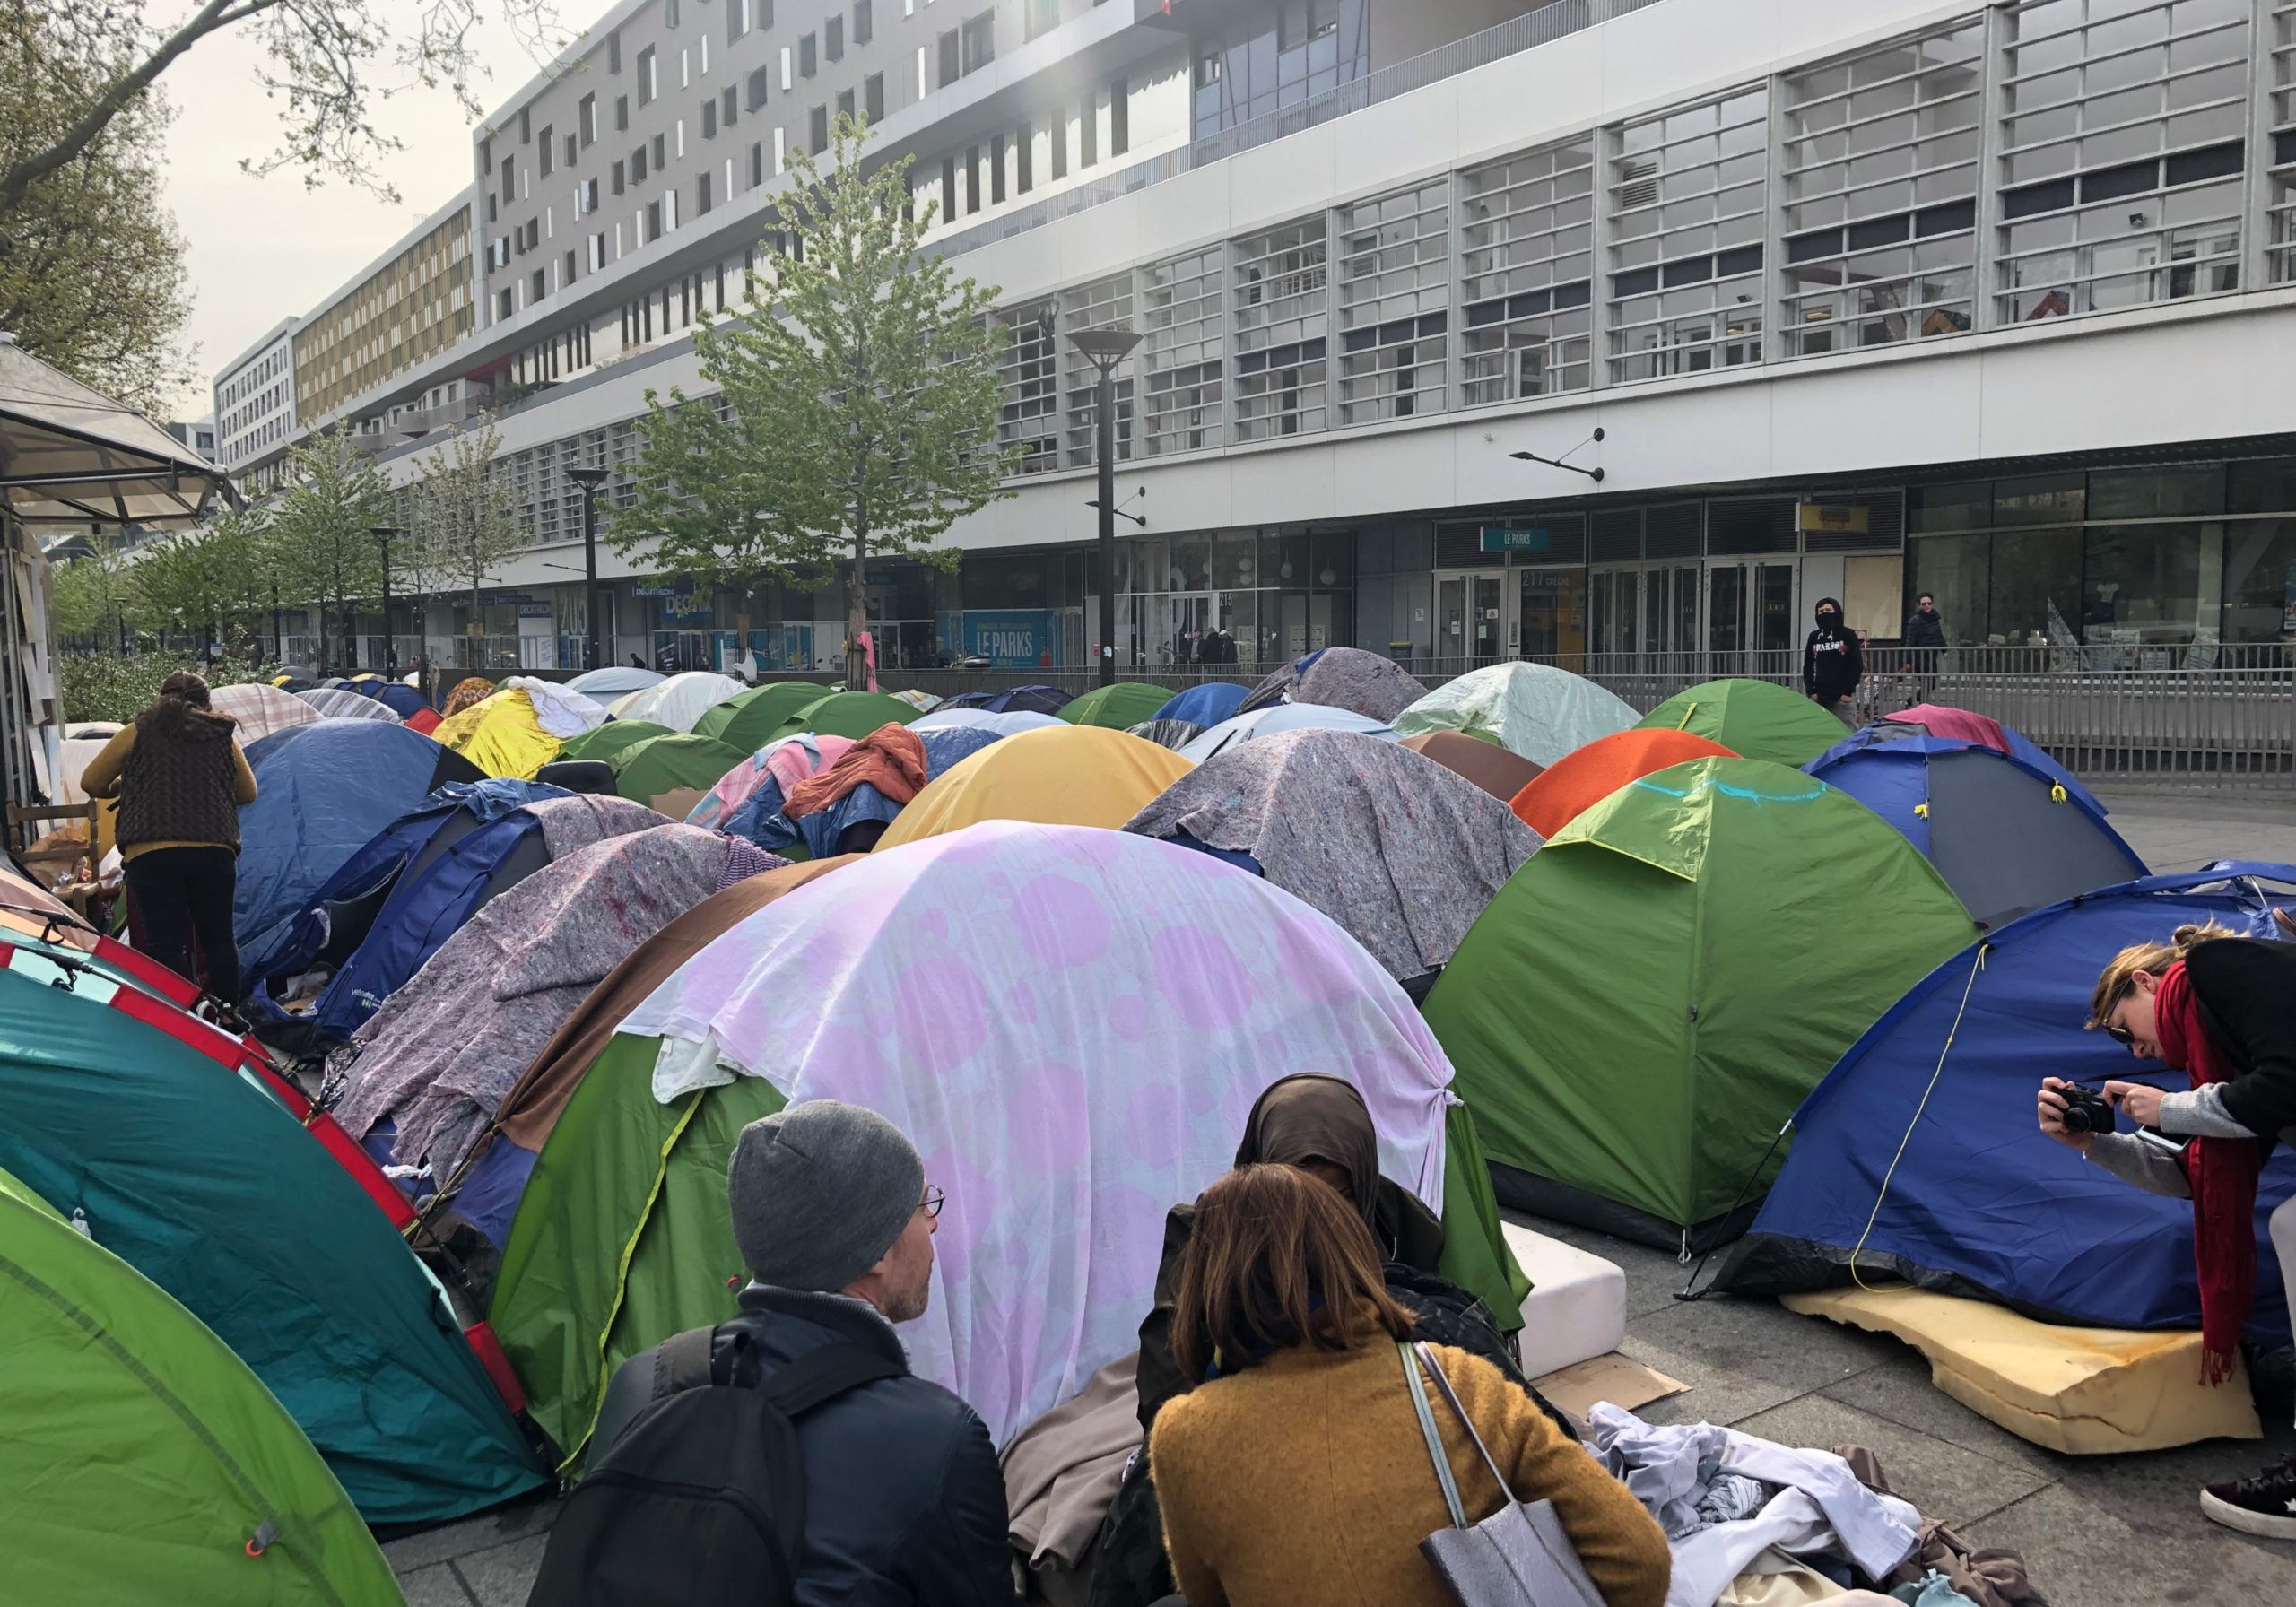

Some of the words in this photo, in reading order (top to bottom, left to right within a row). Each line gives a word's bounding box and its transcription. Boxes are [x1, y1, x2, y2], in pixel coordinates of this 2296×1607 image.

[1504, 533, 1511, 545] LE
[1512, 533, 1531, 545] PARKS
[1522, 570, 1544, 586] 217
[636, 587, 674, 596] DECATHLON
[1220, 593, 1233, 607] 215
[976, 630, 990, 656] LE
[992, 630, 1033, 657] PARKS
